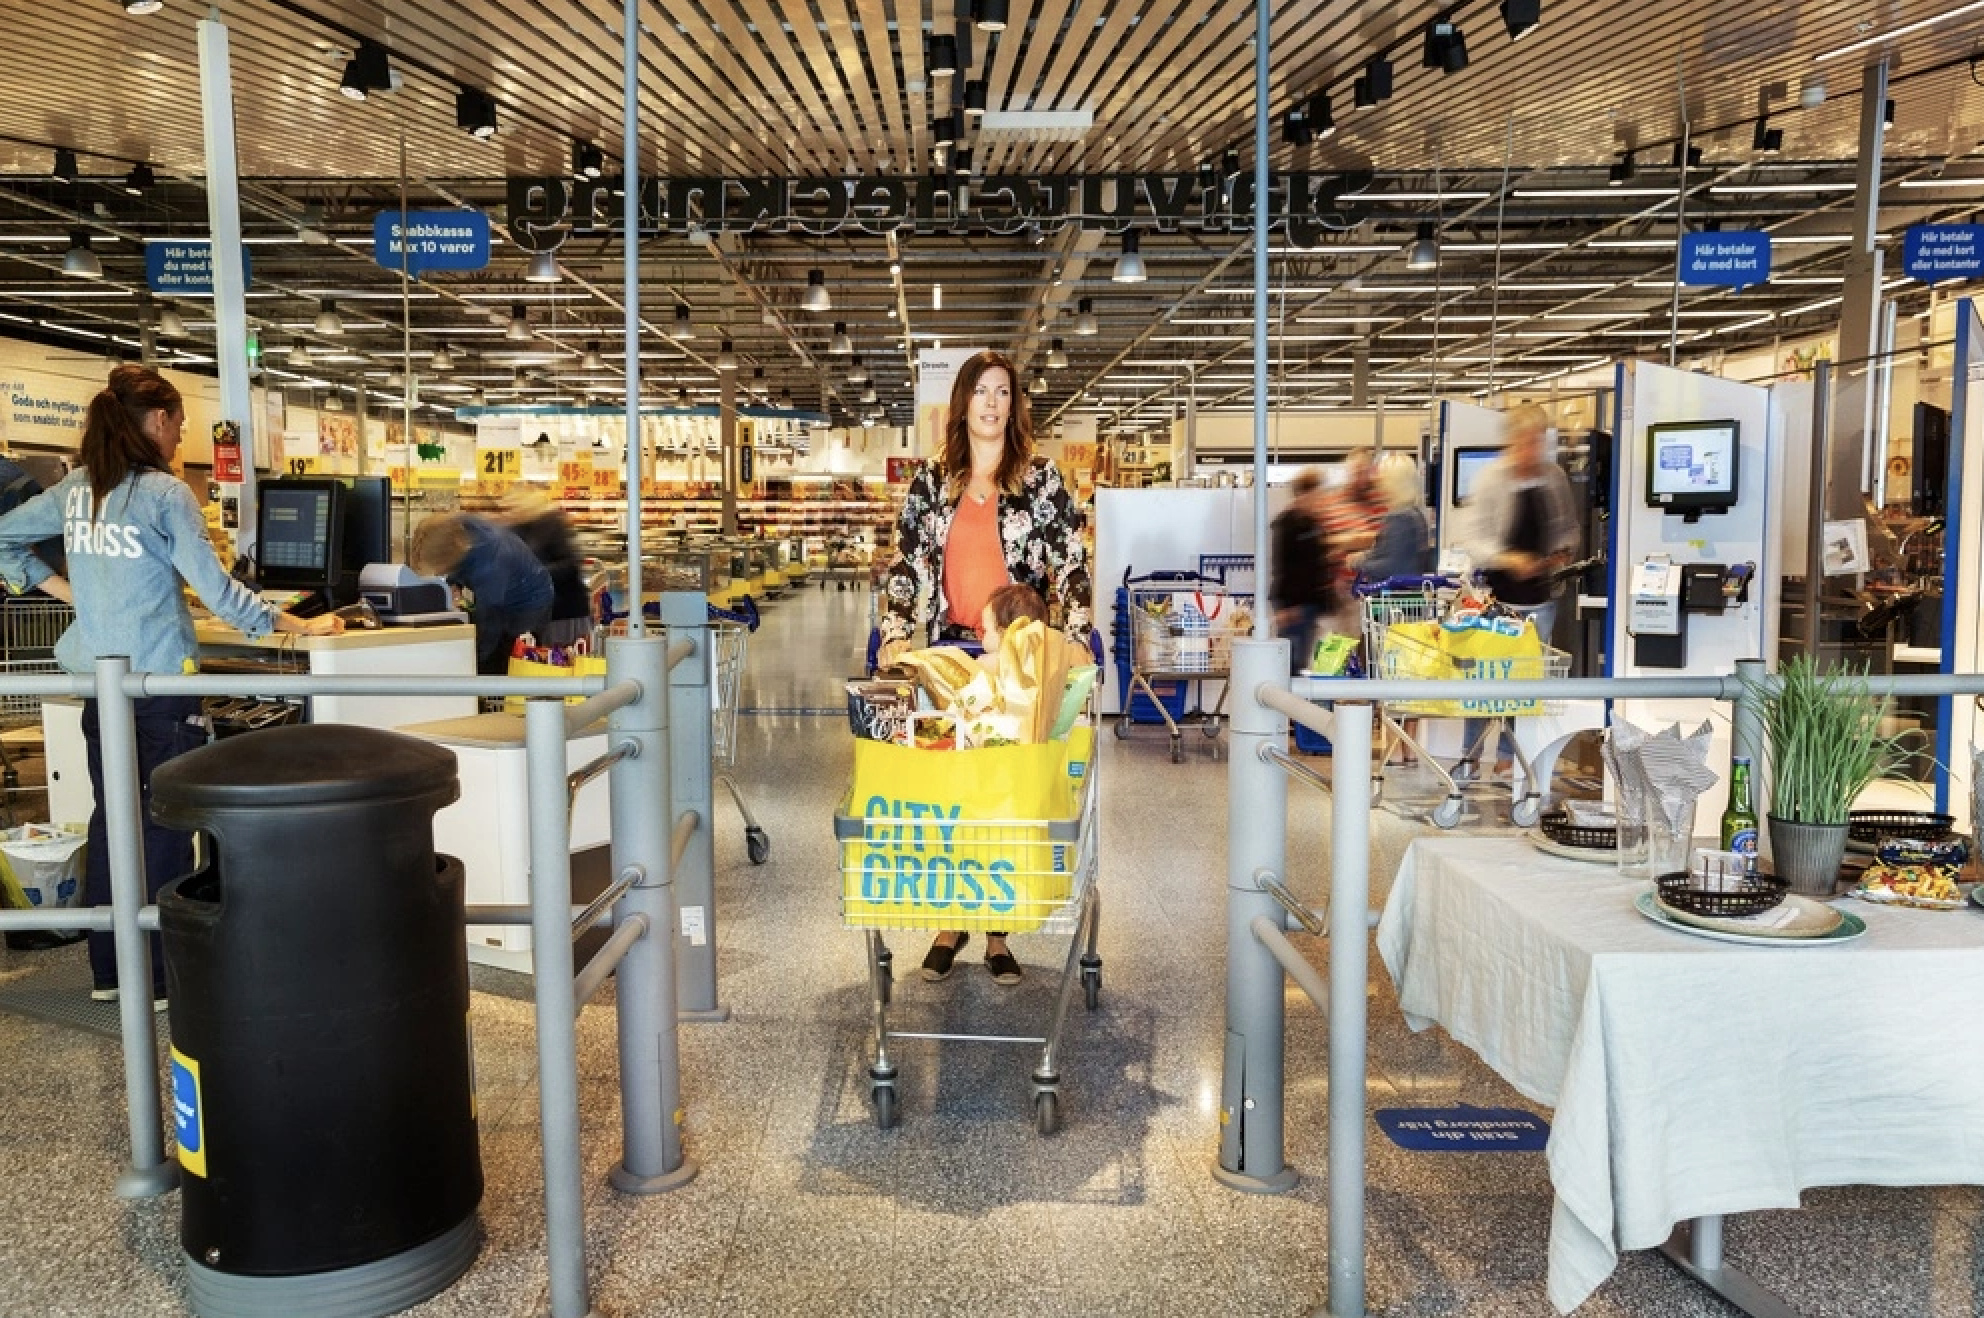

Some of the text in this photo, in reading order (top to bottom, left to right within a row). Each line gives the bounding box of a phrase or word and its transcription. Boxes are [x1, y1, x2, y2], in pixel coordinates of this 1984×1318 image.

[391, 223, 473, 238] Snabbkassa
[1921, 229, 1975, 243] Här betalar
[165, 247, 187, 259] Här
[389, 240, 477, 255] Max 10 varor
[1695, 241, 1757, 256] Här betalar
[1917, 244, 1975, 257] du med kort
[163, 259, 179, 271] du
[181, 259, 207, 271] med
[1691, 257, 1757, 271] du med kort
[1911, 257, 1981, 271] eller kontanter
[157, 273, 182, 285] eller
[64, 521, 143, 559] GROSS
[865, 795, 962, 854] CITY
[861, 852, 1017, 913] GROSS
